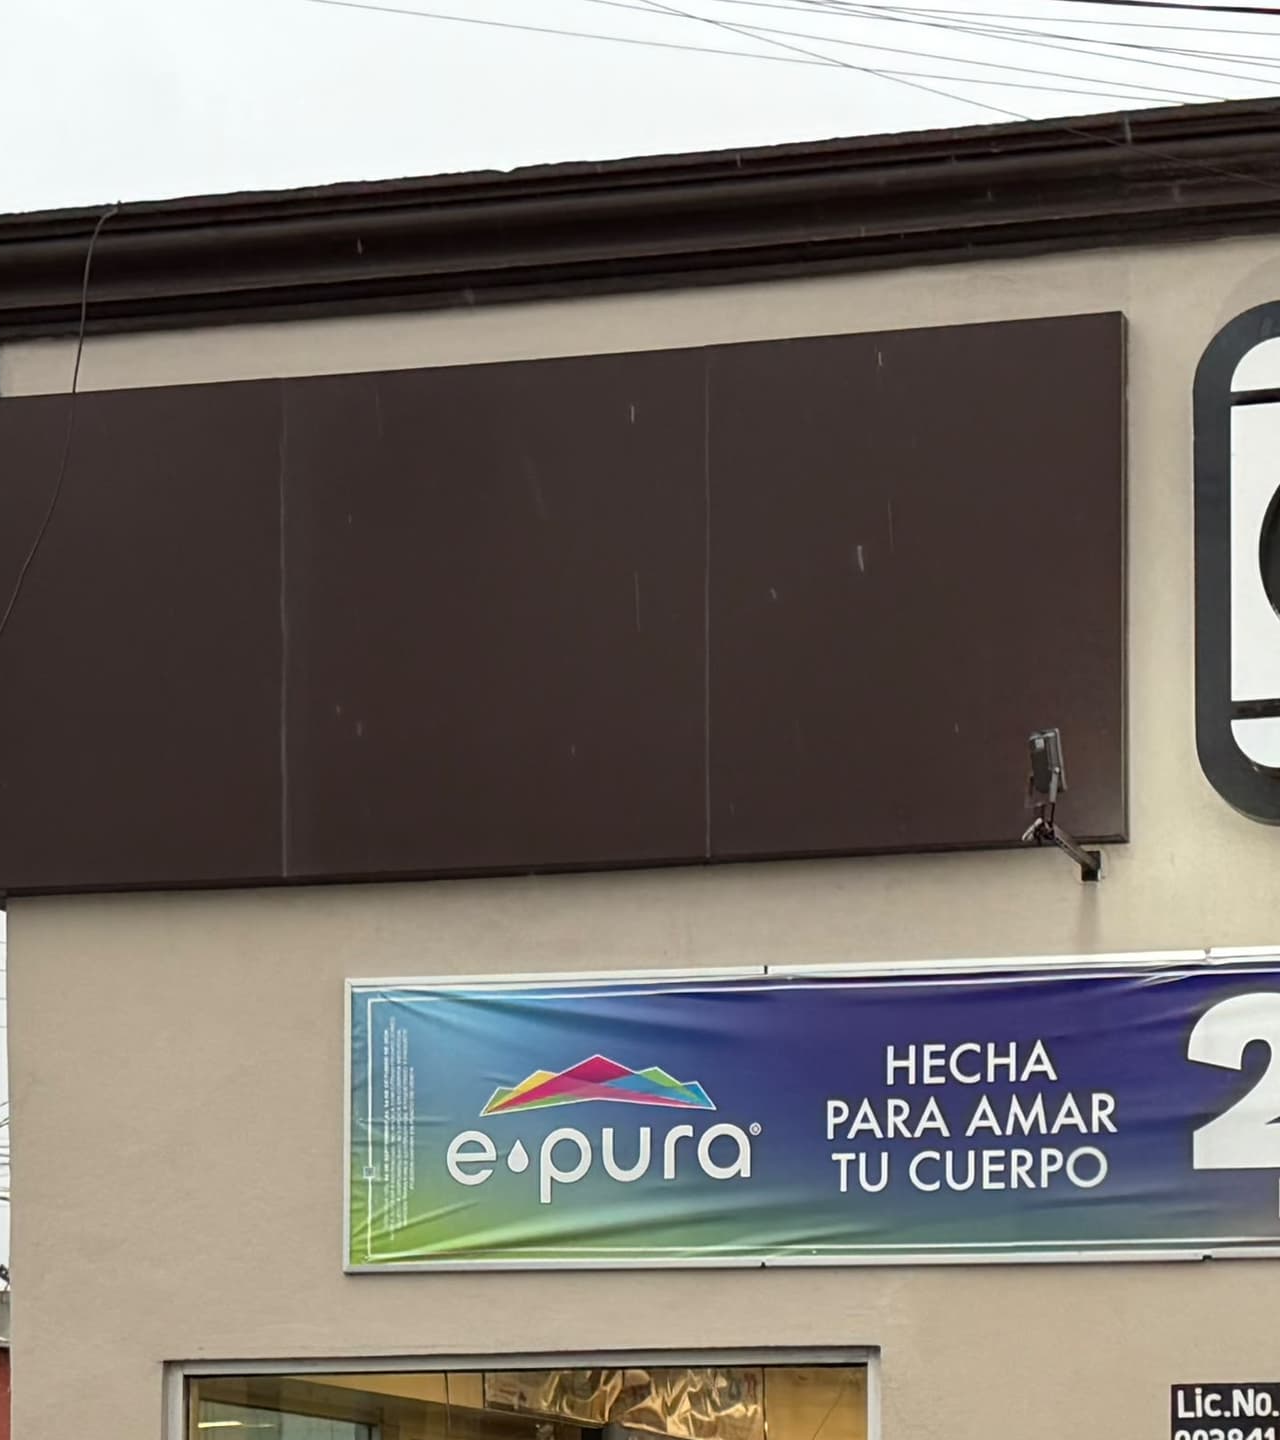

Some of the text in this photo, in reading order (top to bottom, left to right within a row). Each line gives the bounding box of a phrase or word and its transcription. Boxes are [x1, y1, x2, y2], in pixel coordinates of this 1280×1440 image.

[886, 1039, 1058, 1087] HECHA
[827, 1092, 1119, 1141] PARA AMAR
[831, 1144, 1109, 1194] TU CUERPO
